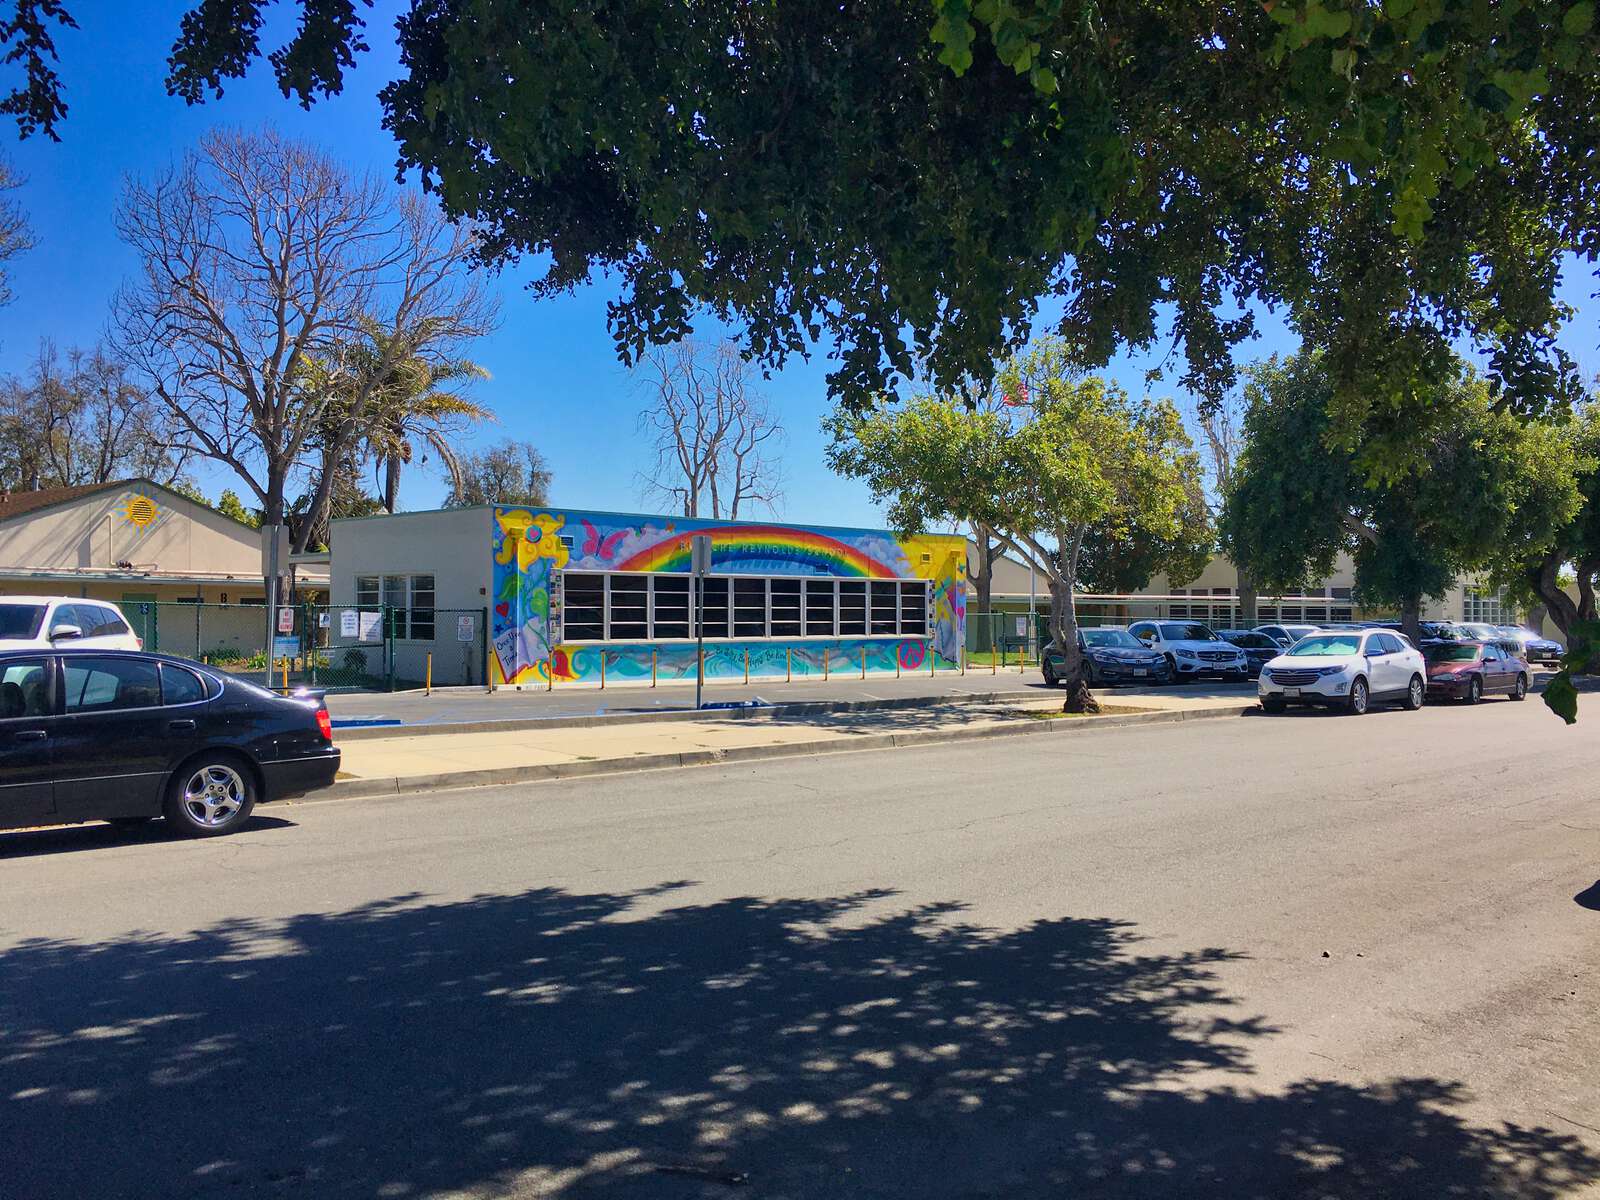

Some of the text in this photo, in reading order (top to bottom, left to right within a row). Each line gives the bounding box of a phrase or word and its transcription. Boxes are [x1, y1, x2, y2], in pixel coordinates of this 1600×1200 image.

[679, 542, 733, 553] BLCHE
[742, 543, 800, 555] REYNOLDS
[220, 592, 228, 603] B
